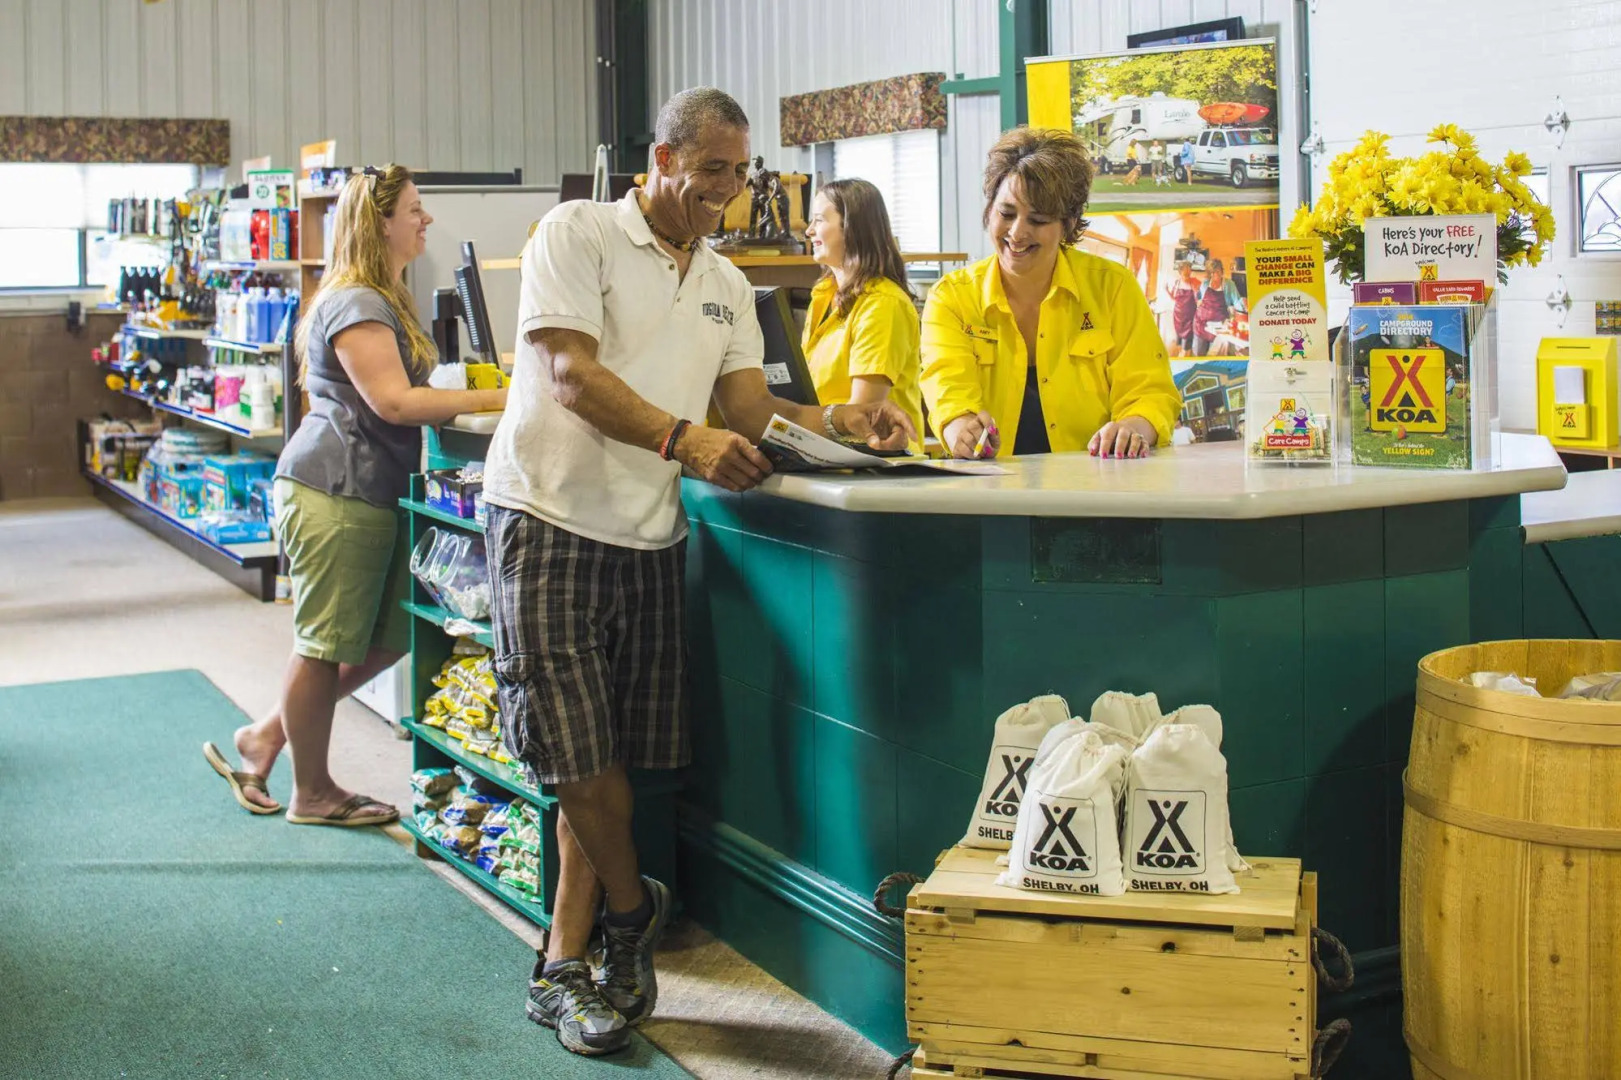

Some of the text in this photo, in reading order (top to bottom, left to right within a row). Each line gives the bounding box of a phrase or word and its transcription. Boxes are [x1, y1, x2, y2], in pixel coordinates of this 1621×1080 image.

[1382, 225, 1475, 242] Here's your FREE
[1255, 263, 1294, 271] CHANGE
[1259, 270, 1285, 278] MAKE
[1258, 277, 1313, 285] DIFFERENCE
[1285, 302, 1310, 310] battling
[1380, 327, 1433, 335] DIRECTORY
[1377, 408, 1437, 423] KOA
[1268, 437, 1309, 446] Care Camps
[1382, 447, 1435, 456] YELLOW SIGN?
[986, 801, 1018, 816] KO
[978, 826, 1013, 840] SHELB
[1030, 852, 1090, 871] KOA
[1137, 852, 1198, 868] KOA
[1079, 884, 1099, 893] OH
[1132, 879, 1209, 891] SHELBY, OH
